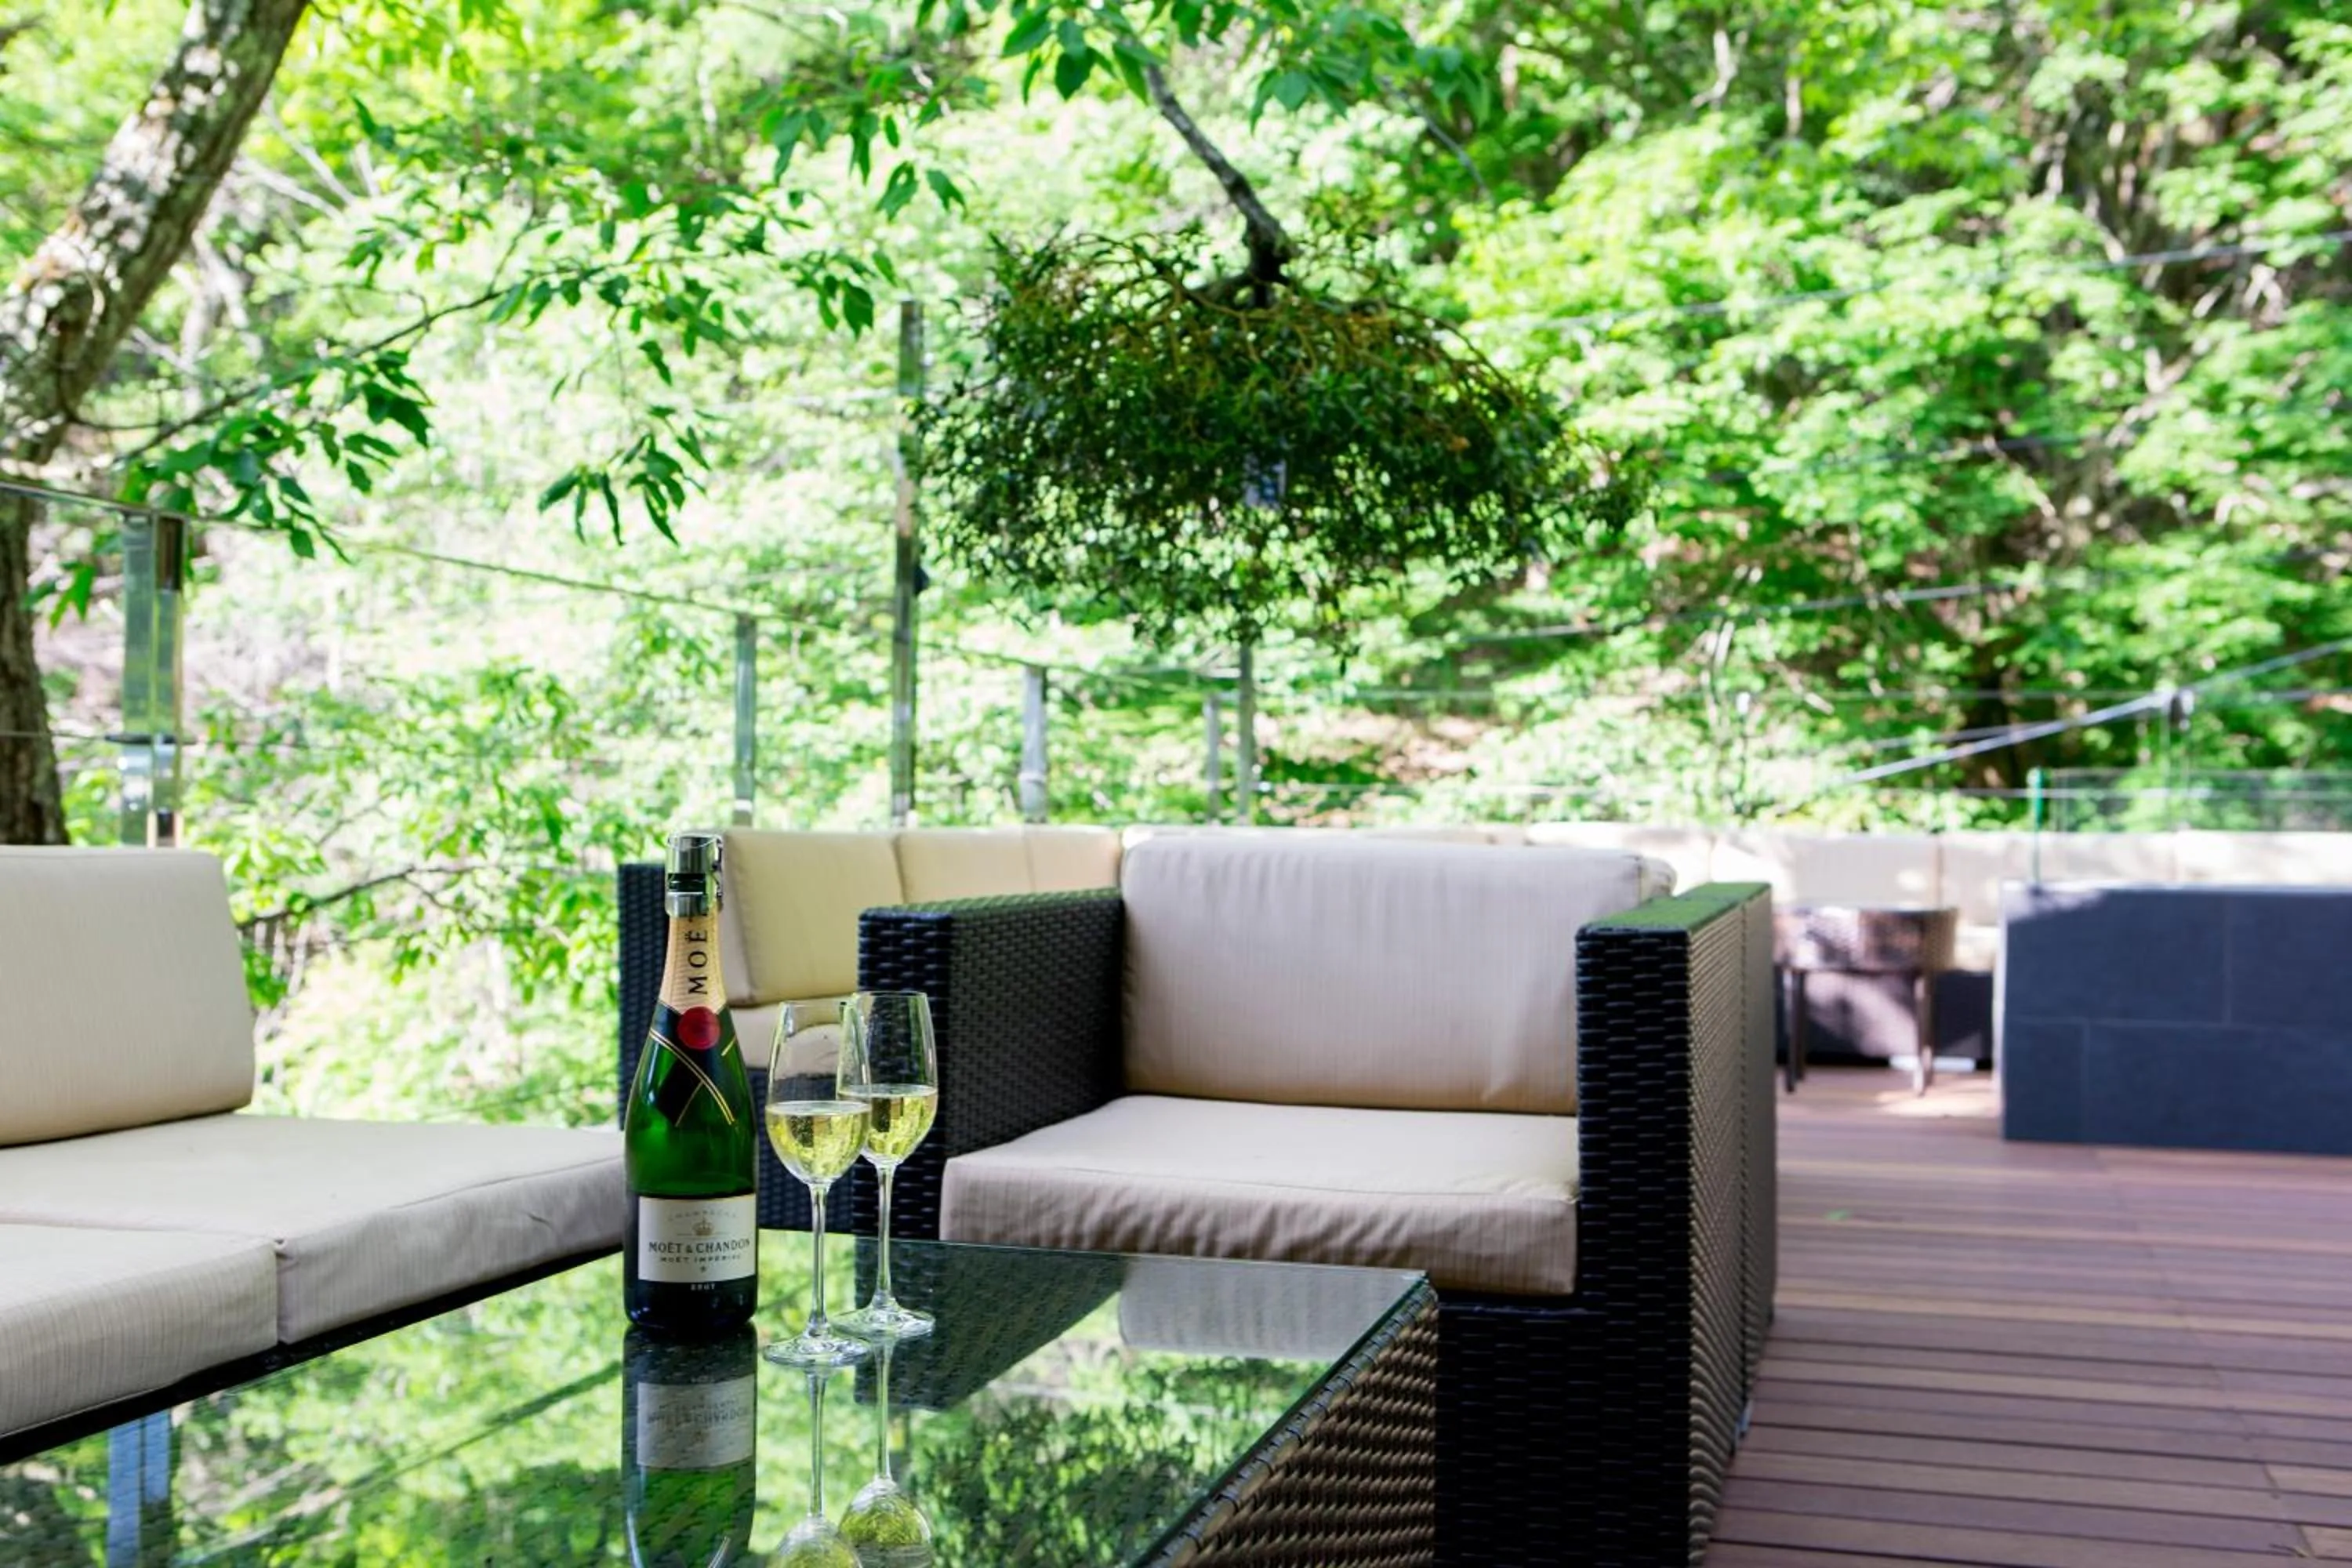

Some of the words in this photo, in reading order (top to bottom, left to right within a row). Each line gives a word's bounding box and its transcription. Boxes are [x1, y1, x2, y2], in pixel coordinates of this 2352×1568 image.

[685, 917, 708, 995] MOË
[686, 1245, 693, 1254] &
[695, 1239, 750, 1254] CHANDON
